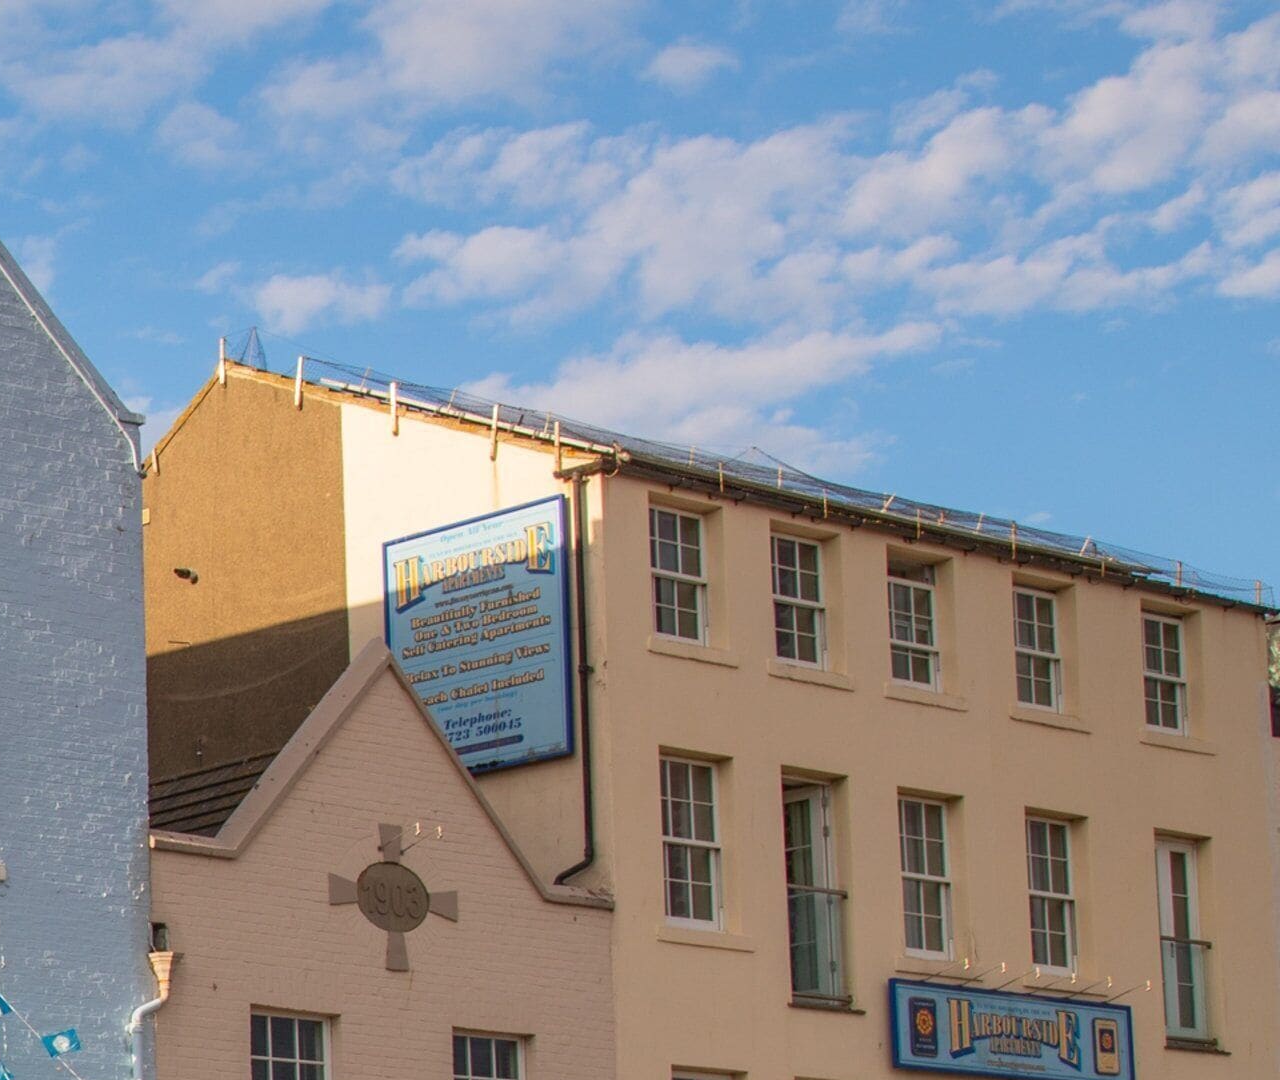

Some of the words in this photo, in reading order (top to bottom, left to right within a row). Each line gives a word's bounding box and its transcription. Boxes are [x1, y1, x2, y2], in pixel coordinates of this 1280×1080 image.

[394, 522, 552, 609] HARBOURSIDE
[411, 605, 477, 629] Beautifully
[480, 588, 540, 613] Furnished
[415, 629, 437, 642] One
[441, 625, 451, 636] &
[454, 620, 479, 633] Two
[482, 605, 537, 626] Bedroom
[402, 645, 425, 660] Self
[428, 633, 478, 652] Catering
[481, 615, 551, 642] Apartments
[442, 665, 457, 676] To
[459, 653, 513, 673] Stunning
[515, 642, 550, 659] Views
[450, 684, 488, 700] Chalet
[492, 668, 544, 691] Included
[444, 708, 512, 731] Telephone:
[476, 717, 522, 737] 500045
[947, 998, 1080, 1070] HARBOURSIDE
